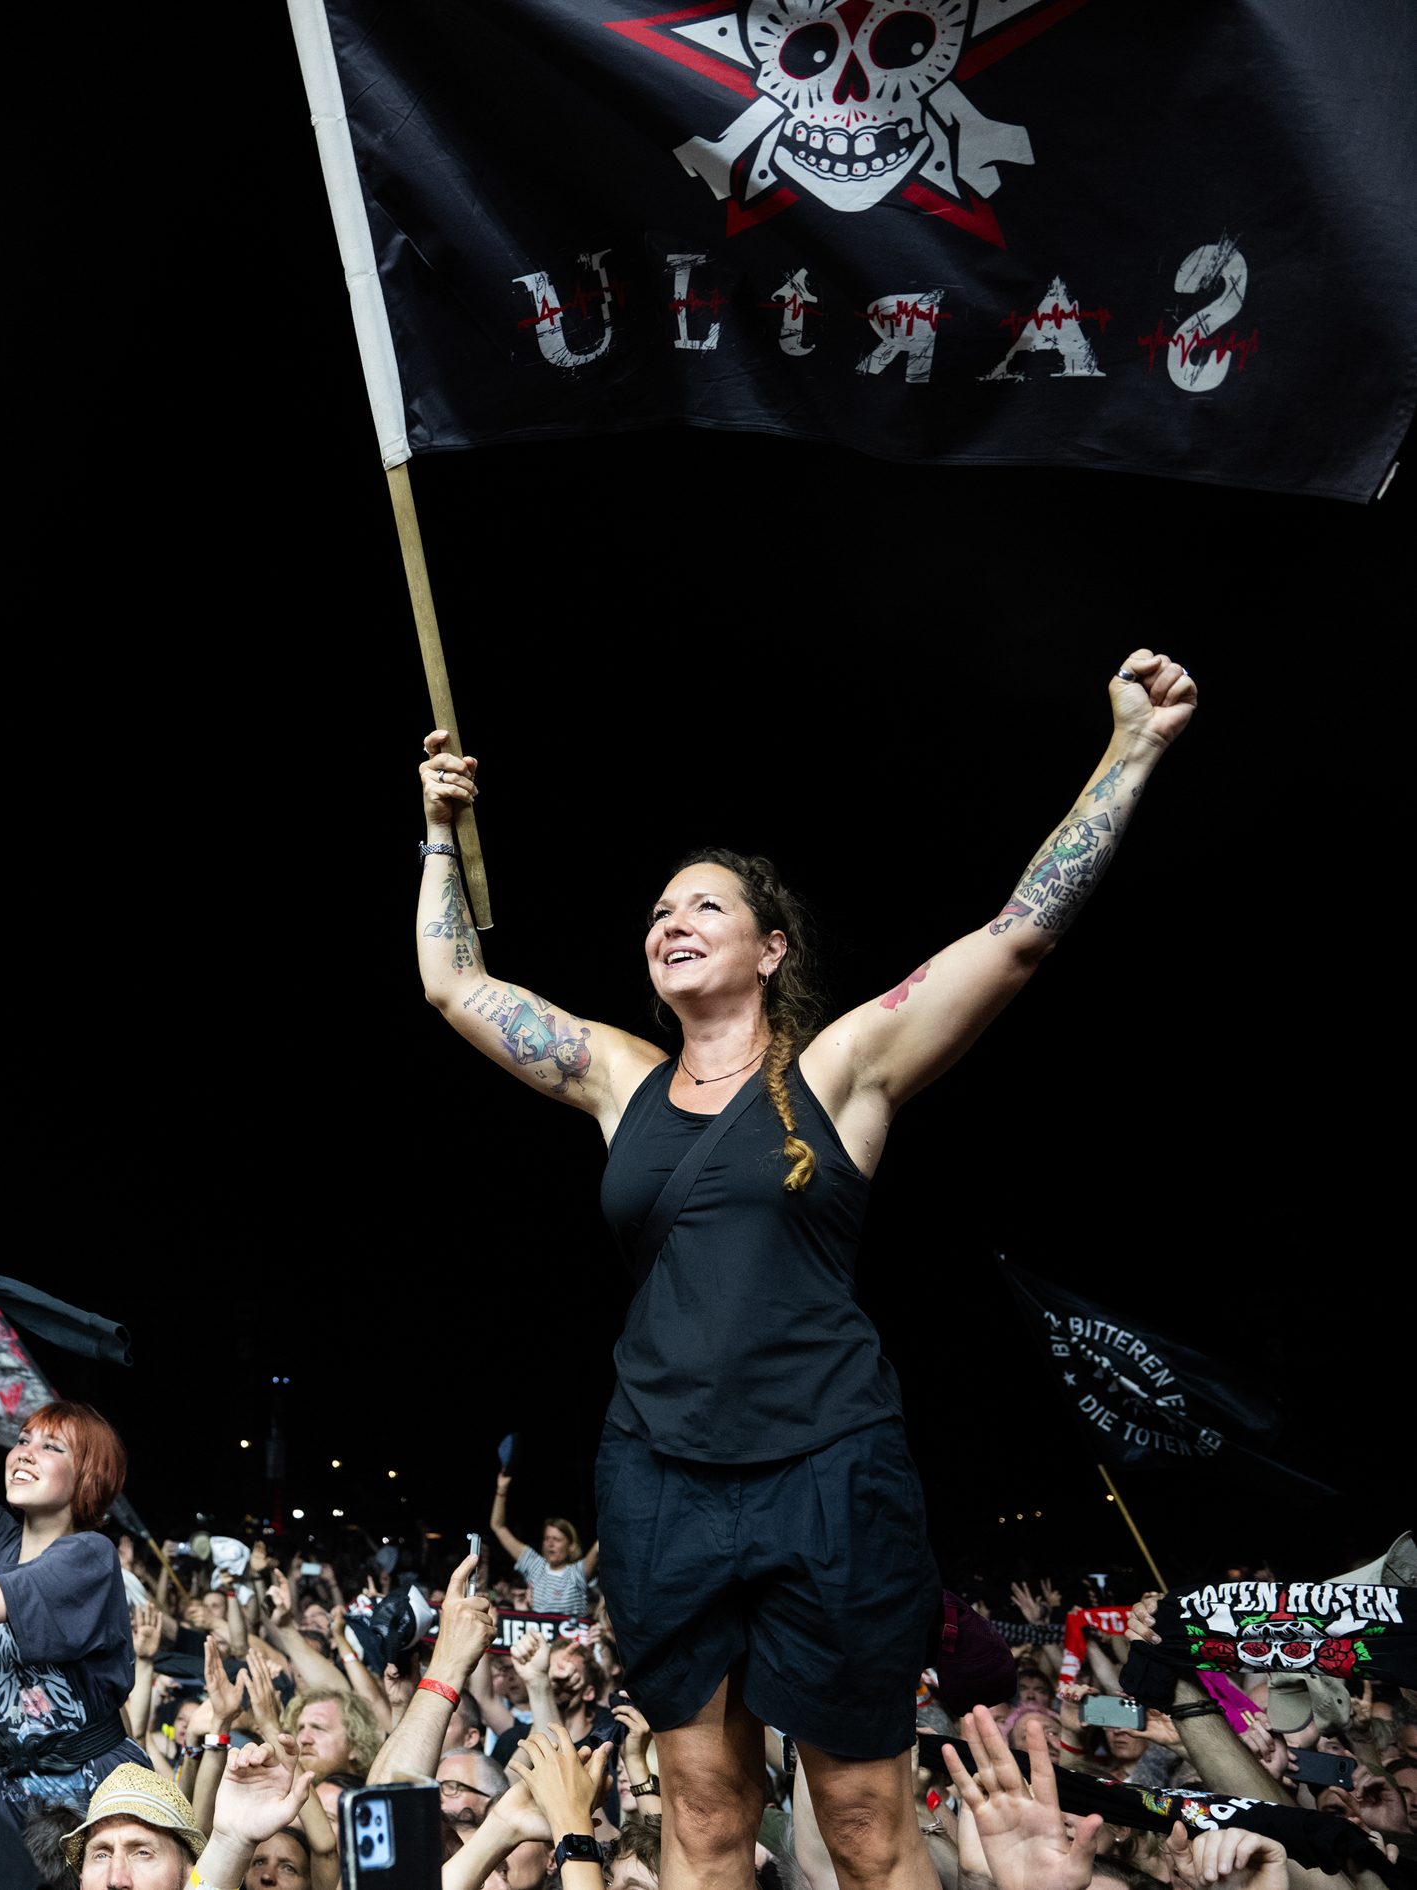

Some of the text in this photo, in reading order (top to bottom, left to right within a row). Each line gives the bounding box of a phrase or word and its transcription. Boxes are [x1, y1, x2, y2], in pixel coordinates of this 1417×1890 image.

[1068, 1316, 1176, 1389] BITTEREN
[1077, 1393, 1120, 1433] DIE
[1177, 1581, 1404, 1624] TOTEN HOSEN
